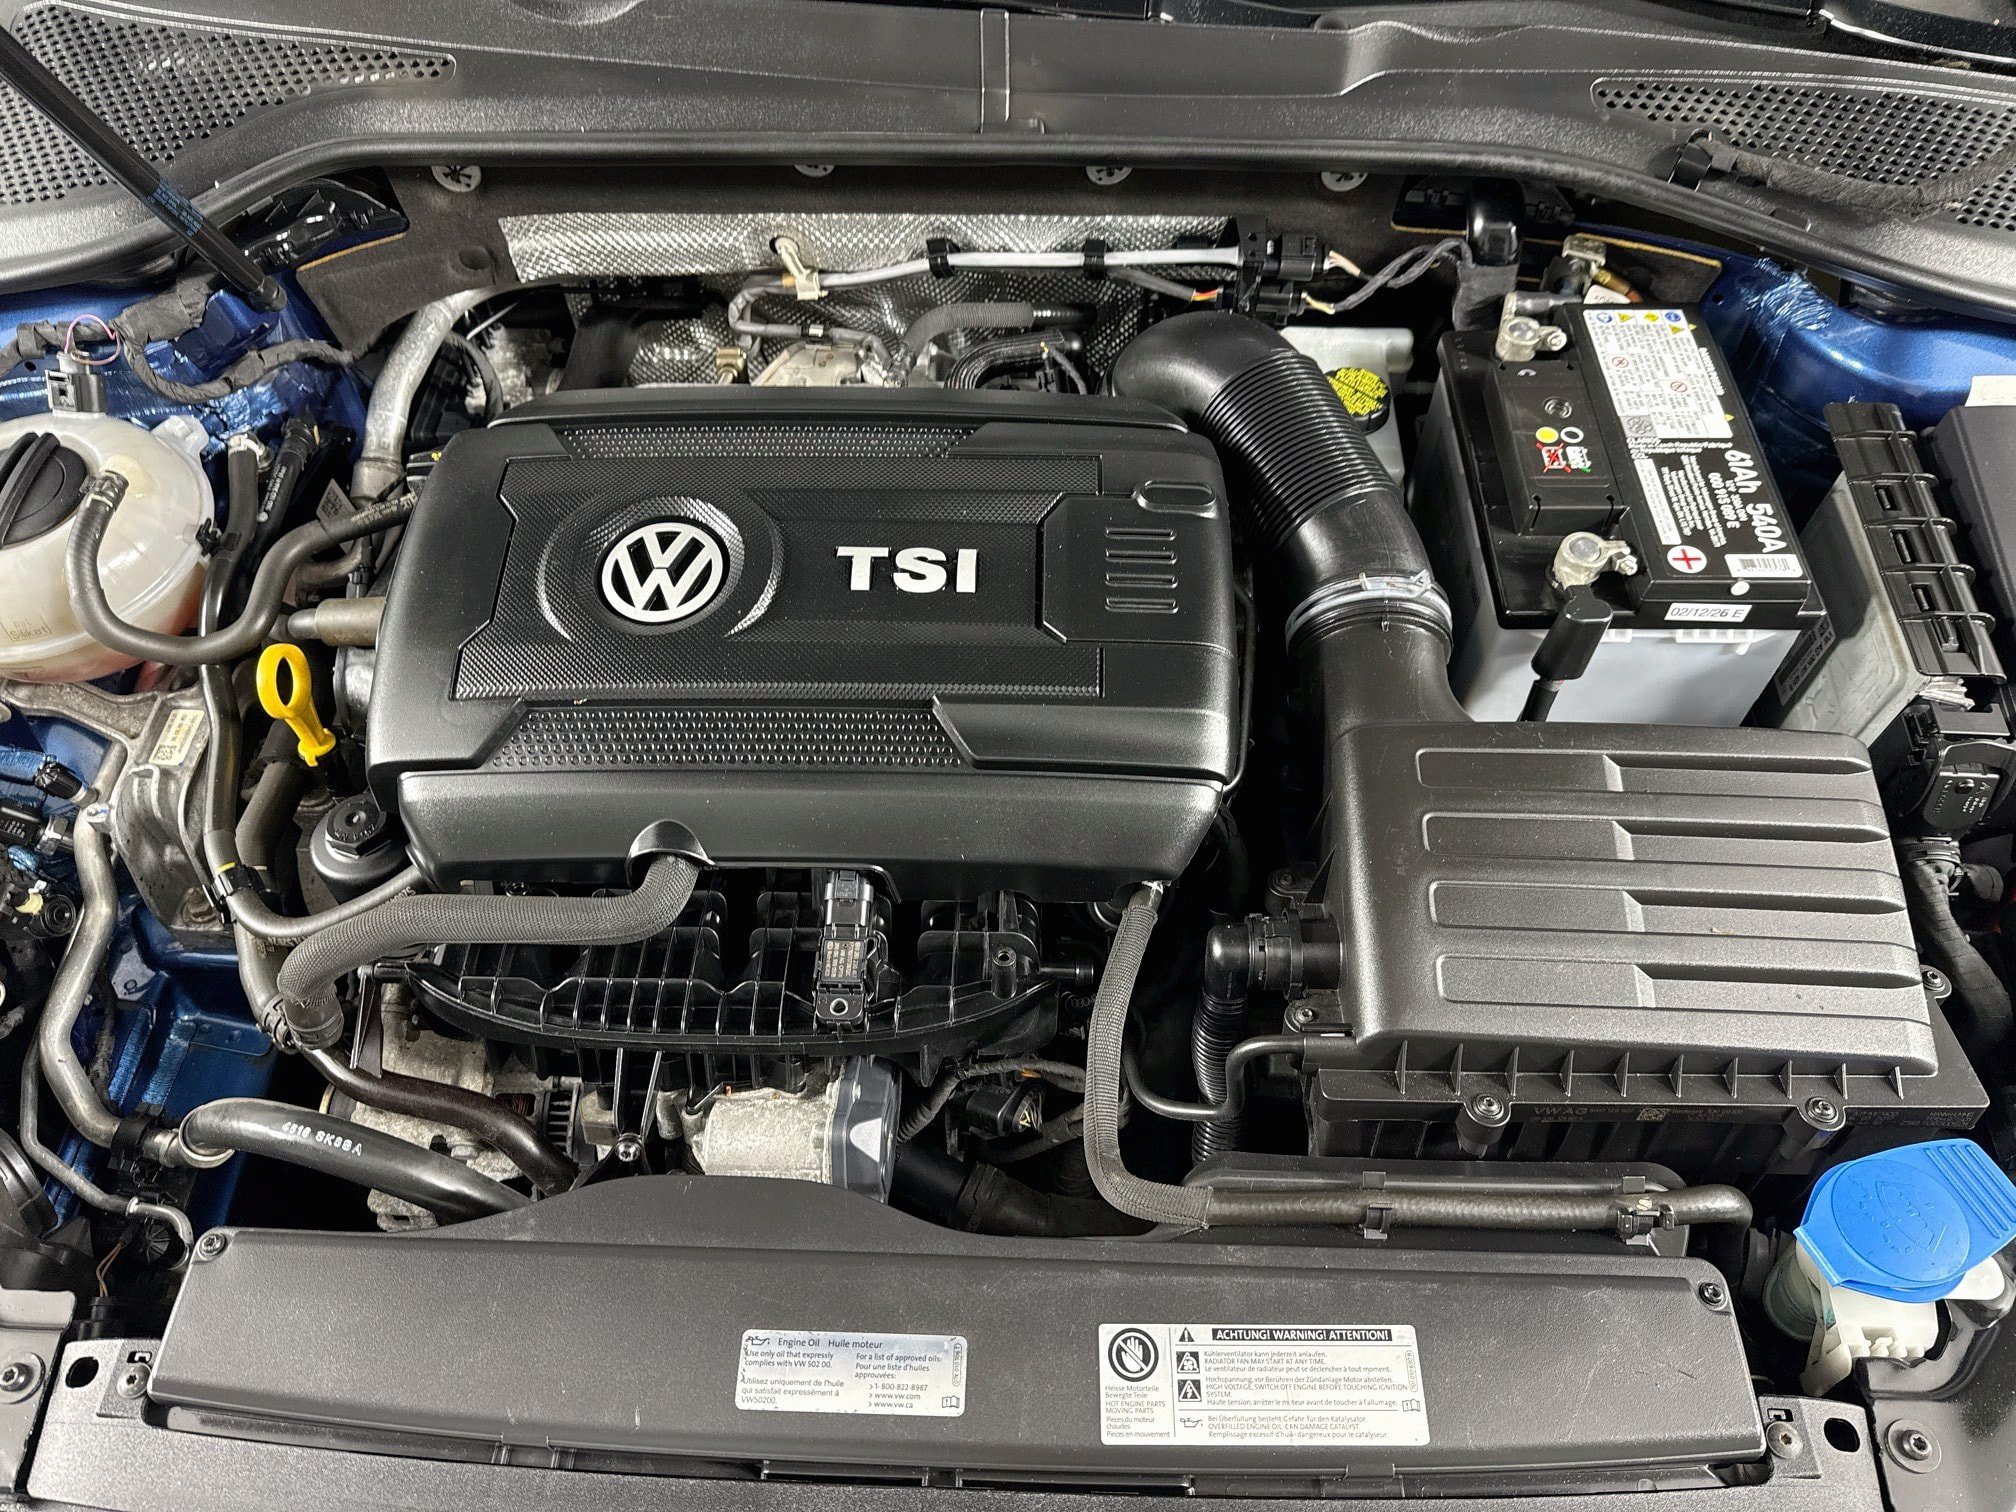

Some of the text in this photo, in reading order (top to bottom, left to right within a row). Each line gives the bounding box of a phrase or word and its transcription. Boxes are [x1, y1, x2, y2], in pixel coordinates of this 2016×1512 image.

[1724, 449, 1762, 494] 61Ah
[1746, 503, 1788, 553] 540A
[836, 545, 979, 594] TSI
[1670, 607, 1744, 618] 02/12/26 E
[1216, 1329, 1389, 1340] ACHTUNG! WARNING! ATTENTION!
[778, 1338, 883, 1349] Engine Oil Huile moteur
[760, 1350, 775, 1359] only
[802, 1351, 834, 1360] expressly
[886, 1353, 894, 1361] of
[895, 1354, 926, 1365] approved
[745, 1360, 775, 1368] complies
[887, 1363, 902, 1371] liste
[770, 1378, 812, 1388] uniquement
[742, 1387, 753, 1396] qui
[754, 1387, 781, 1395] satisfait
